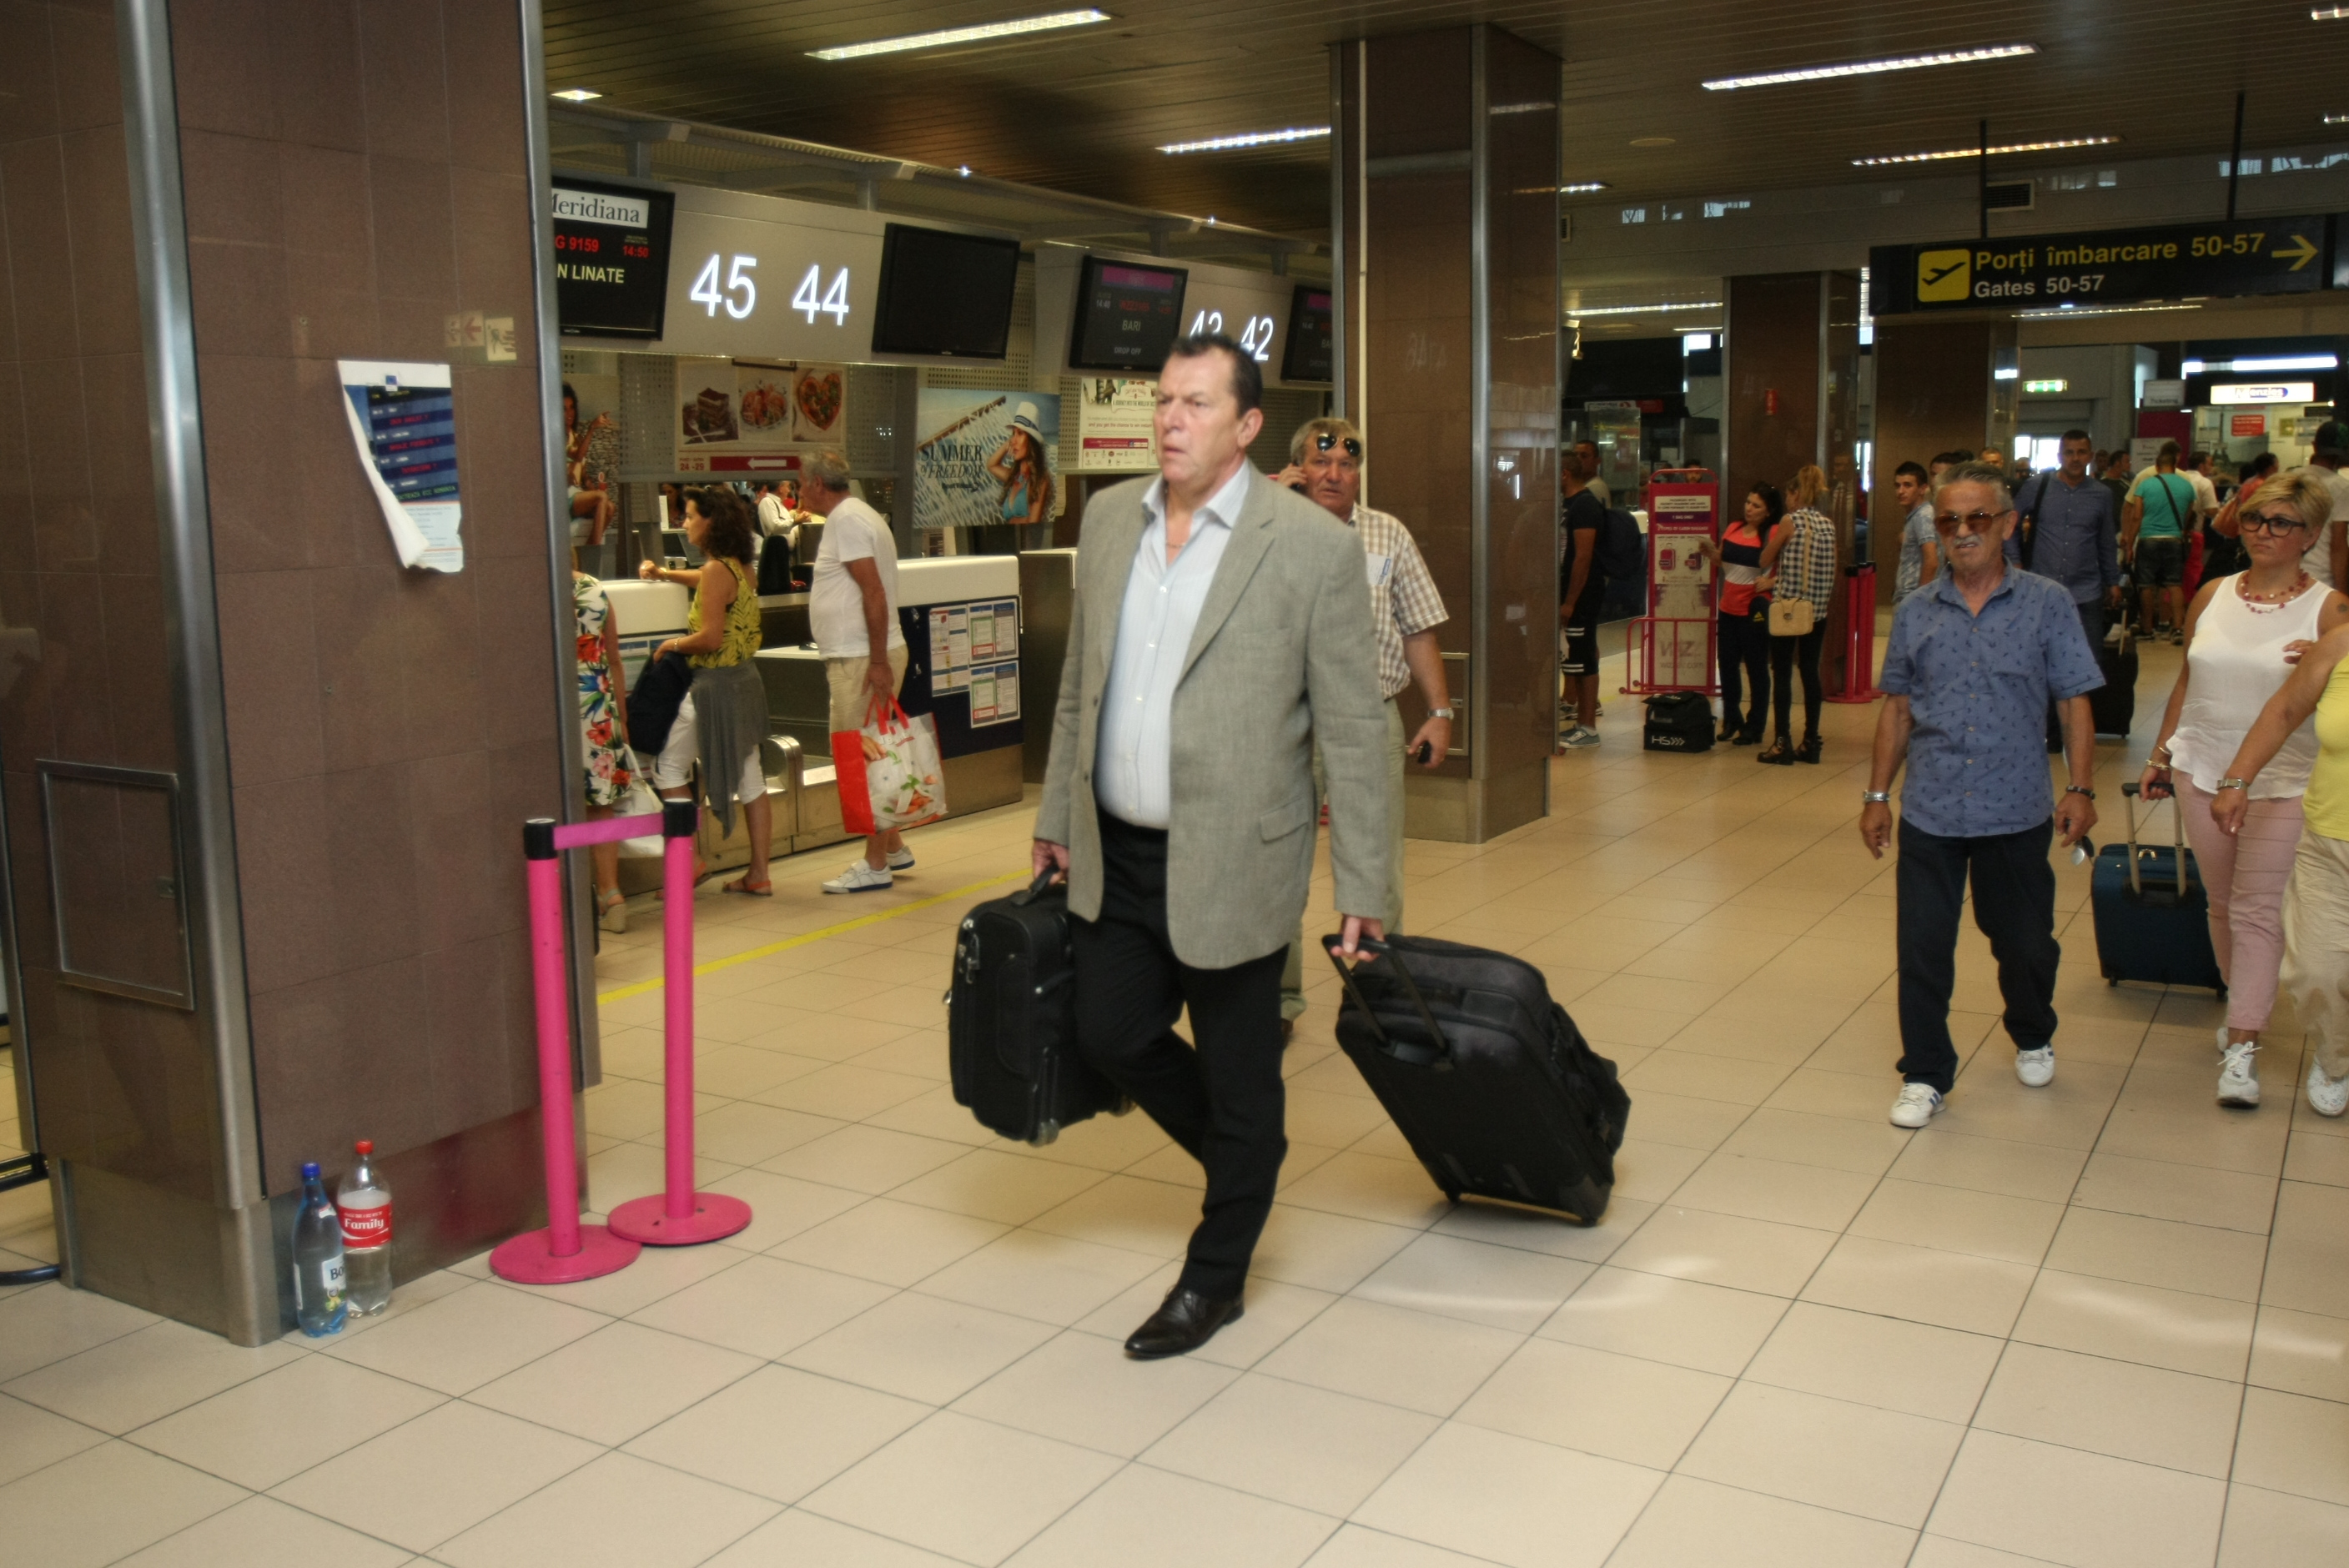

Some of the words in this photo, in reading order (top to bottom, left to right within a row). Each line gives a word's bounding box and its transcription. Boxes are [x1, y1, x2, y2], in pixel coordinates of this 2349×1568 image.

[569, 236, 600, 253] 9159
[622, 245, 650, 258] 14:50
[1976, 249, 2034, 274] Porți
[2047, 240, 2177, 267] îmbarcare
[2191, 233, 2266, 258] 50-57
[572, 264, 625, 284] LINATE
[690, 254, 757, 319] 45
[792, 264, 850, 326] 44
[1974, 279, 2035, 299] Gates
[2045, 274, 2105, 294] 50-57
[1122, 319, 1141, 332] BARI
[1240, 316, 1275, 361] 42
[921, 445, 982, 462] SUMMER
[928, 464, 983, 479] FREEDOM
[345, 1218, 384, 1229] Family
[329, 1266, 345, 1281] Bo
